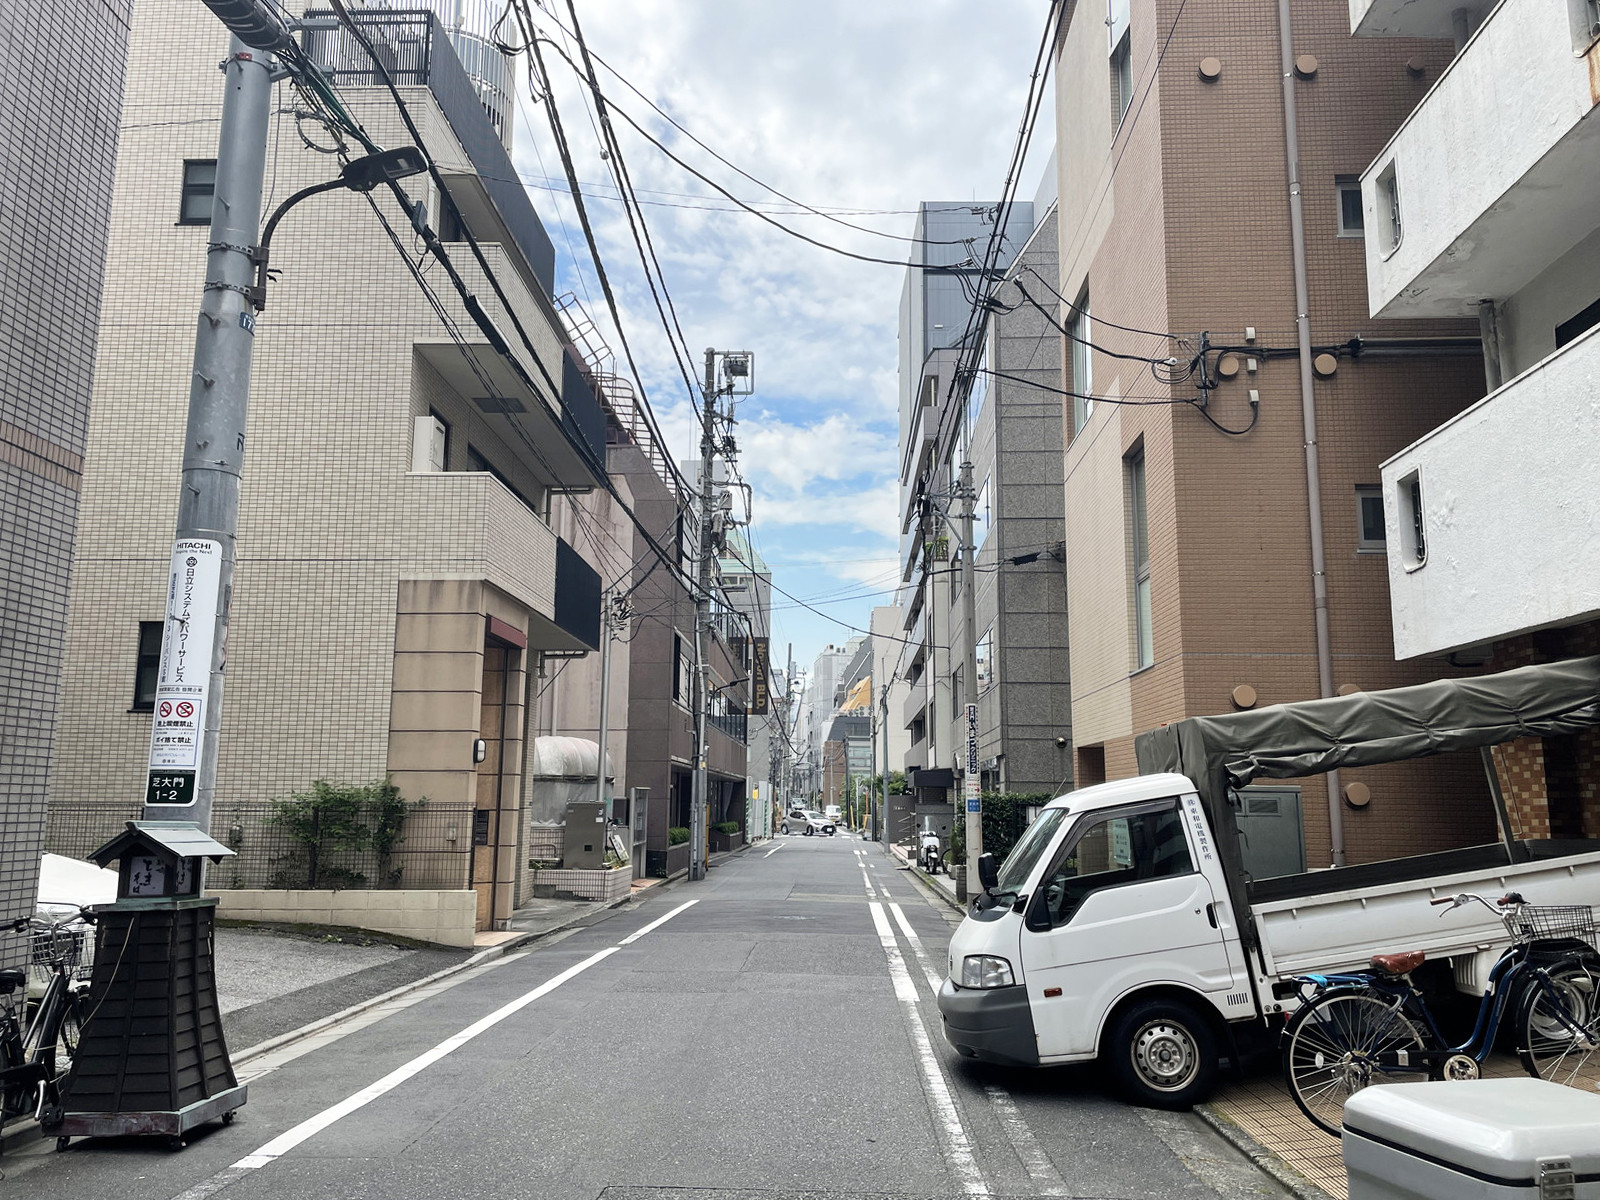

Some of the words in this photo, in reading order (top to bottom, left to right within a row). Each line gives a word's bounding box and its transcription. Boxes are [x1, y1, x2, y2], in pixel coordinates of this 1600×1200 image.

[176, 542, 211, 550] HITACHI
[156, 736, 191, 744] ポイ捨て禁止
[152, 777, 185, 788] 芝大門
[155, 790, 178, 800] 1-2
